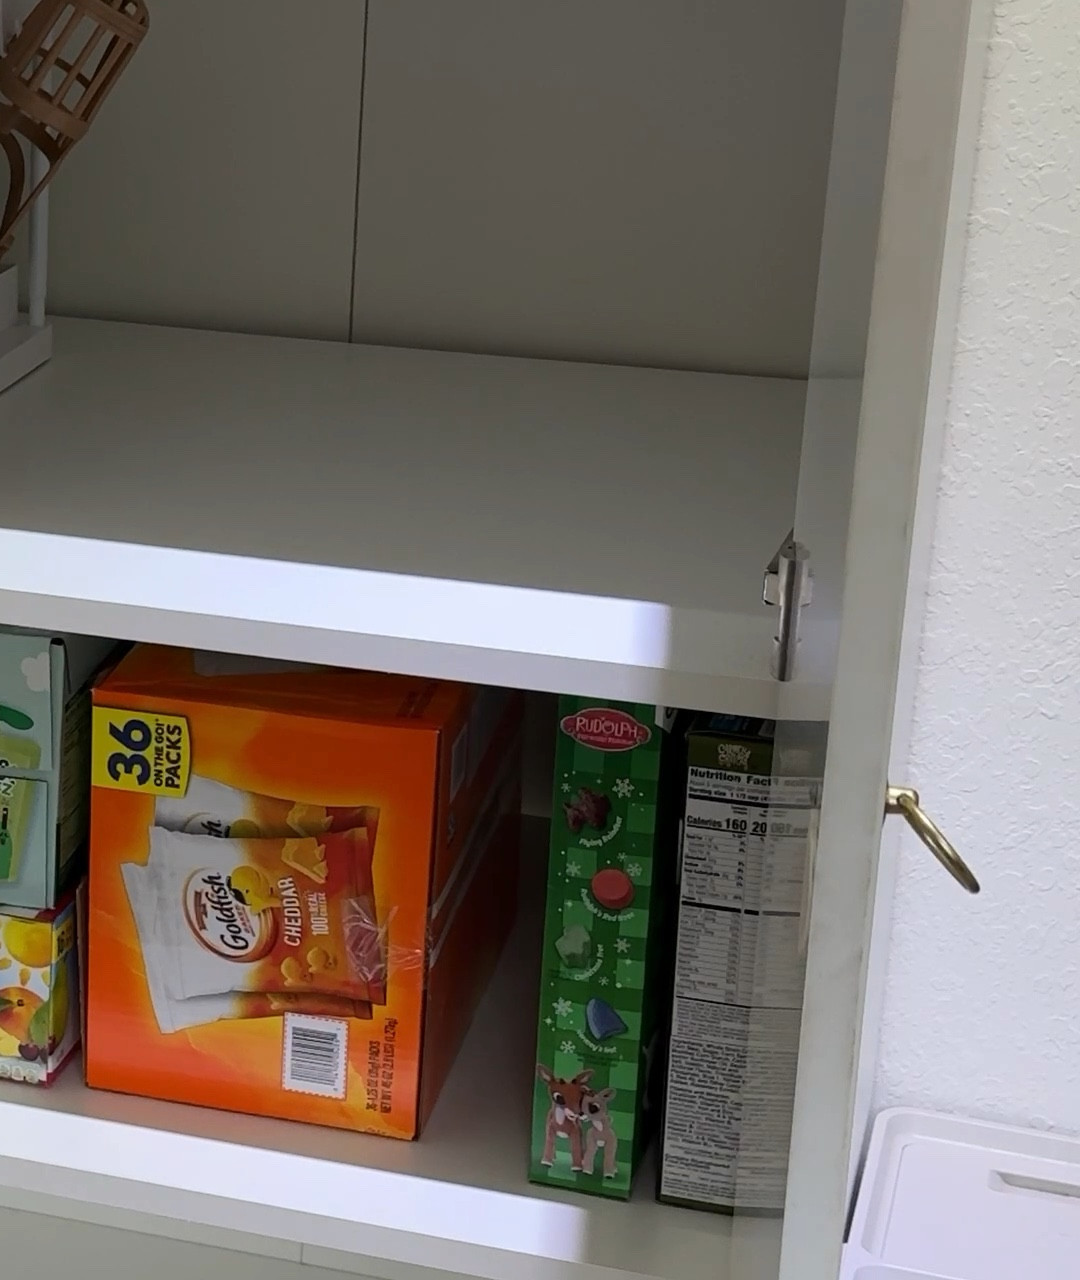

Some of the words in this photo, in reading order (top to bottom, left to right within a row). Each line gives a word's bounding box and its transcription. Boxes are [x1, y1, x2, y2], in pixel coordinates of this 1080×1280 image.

[575, 716, 638, 739] RUDOLPH
[107, 719, 152, 786] 36
[154, 746, 164, 768] THE
[165, 723, 182, 789] PACKS
[153, 769, 164, 787] ON
[689, 767, 742, 784] Nutrition
[745, 775, 772, 787] Fact
[686, 814, 723, 828] Calories
[725, 817, 748, 831] 160
[201, 873, 249, 950] Goldfish
[277, 875, 302, 947] CHEDDAR
[368, 1041, 380, 1062] PACKS
[381, 1090, 392, 1101] WT
[380, 1101, 392, 1114] NET
